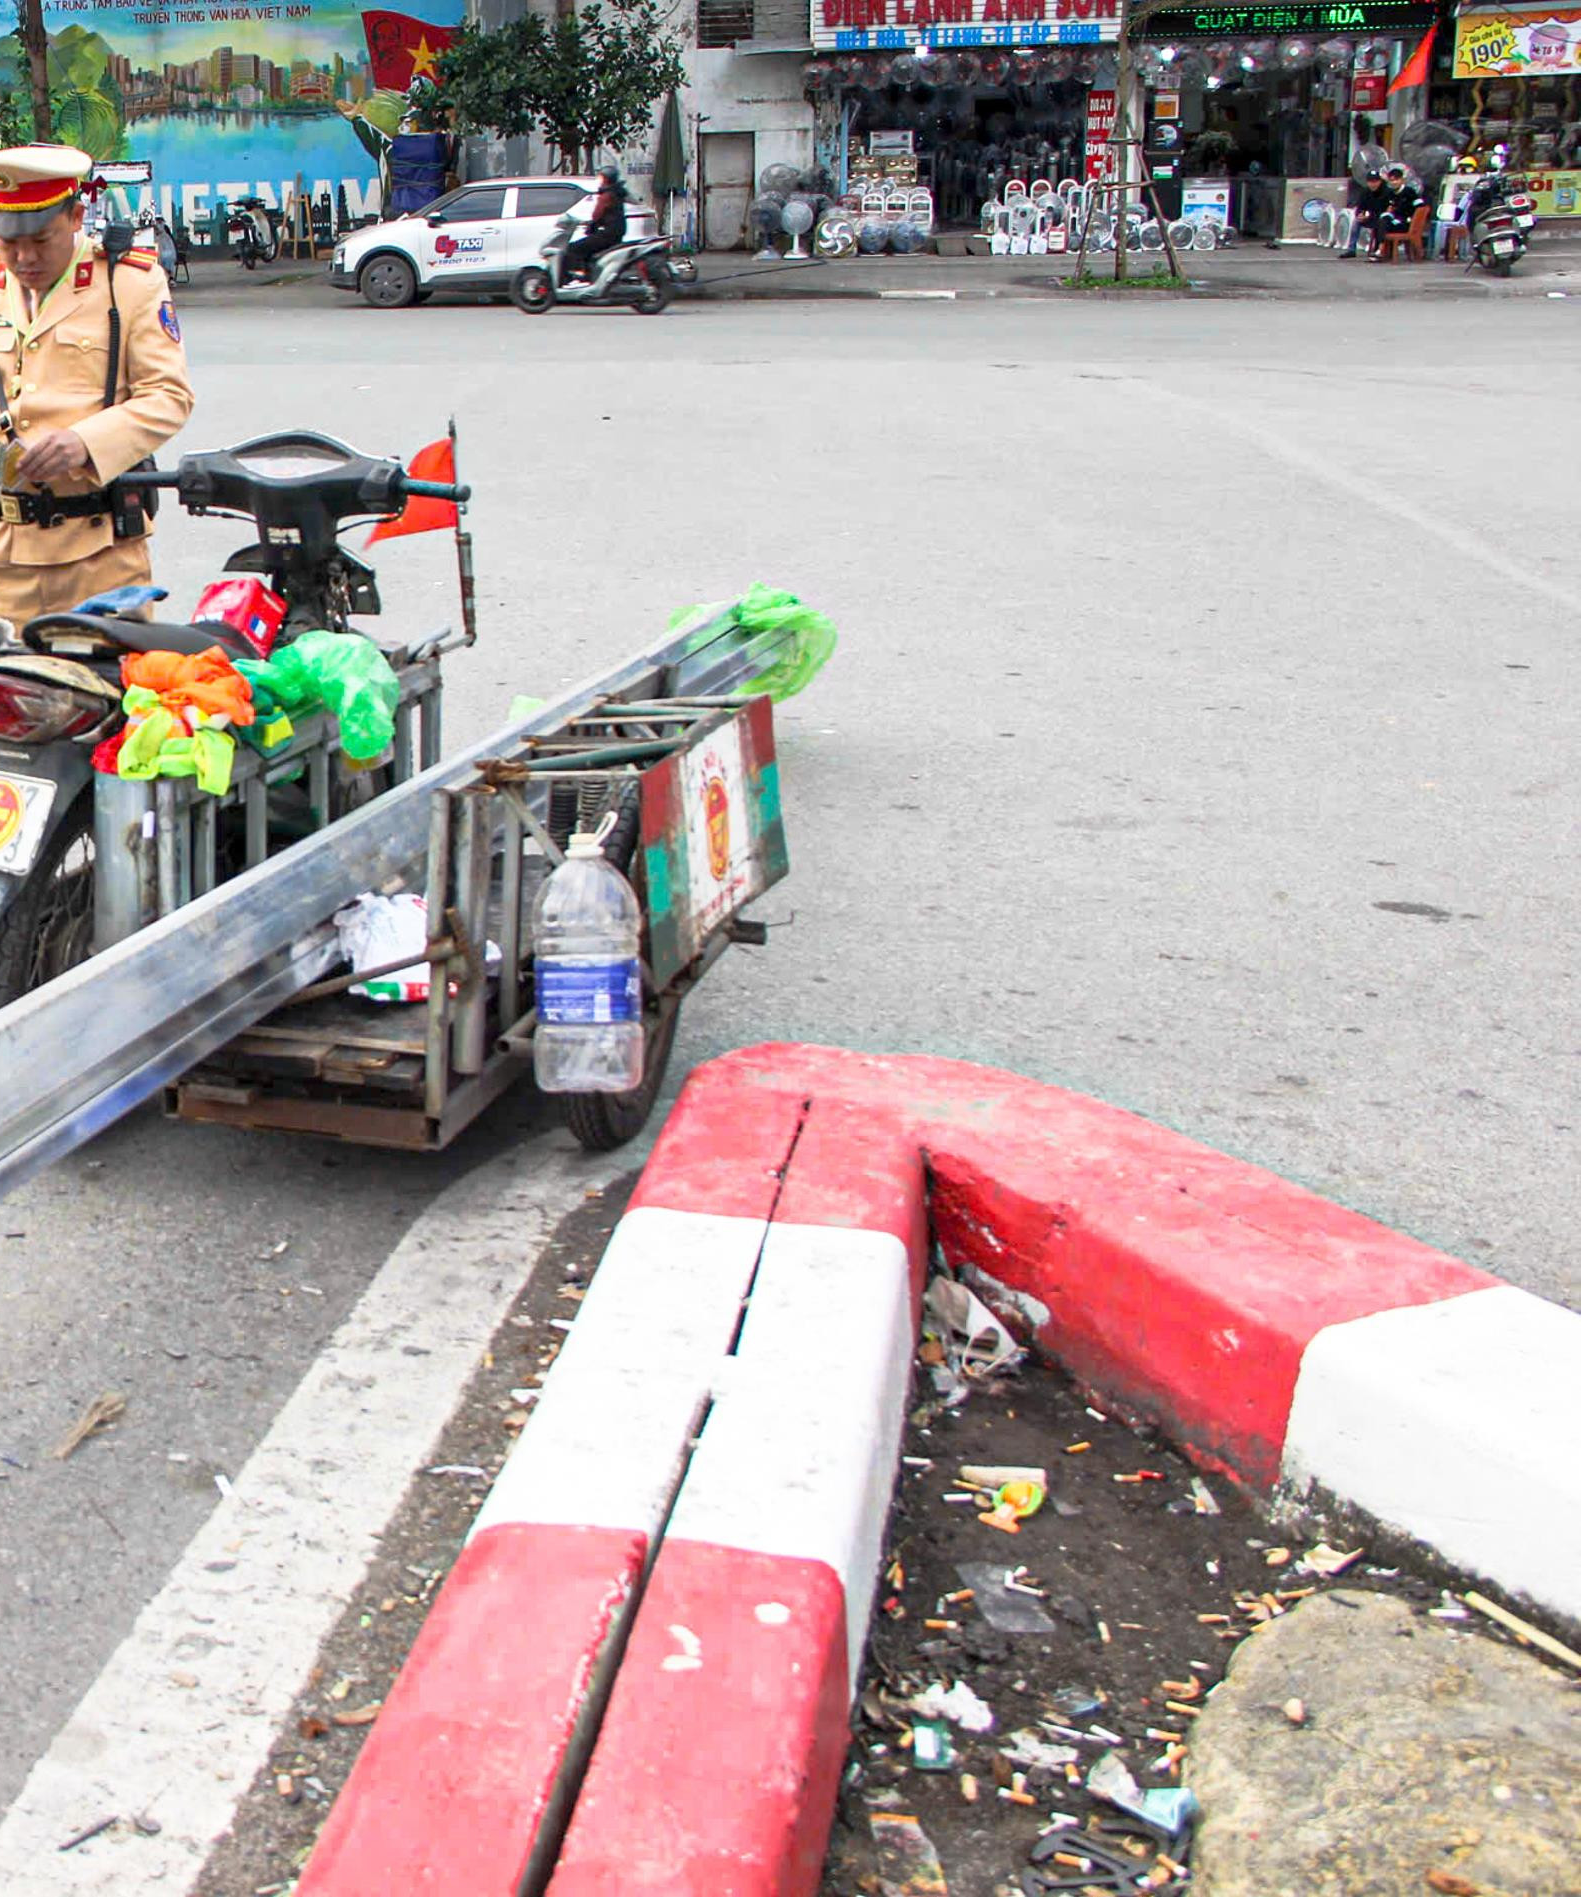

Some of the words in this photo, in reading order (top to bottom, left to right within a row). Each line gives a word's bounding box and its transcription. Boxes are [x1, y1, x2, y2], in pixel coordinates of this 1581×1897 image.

[286, 5, 311, 17] NAM
[1194, 13, 1247, 32] QUẠT
[1303, 11, 1314, 25] 4
[457, 239, 483, 250] TAXI
